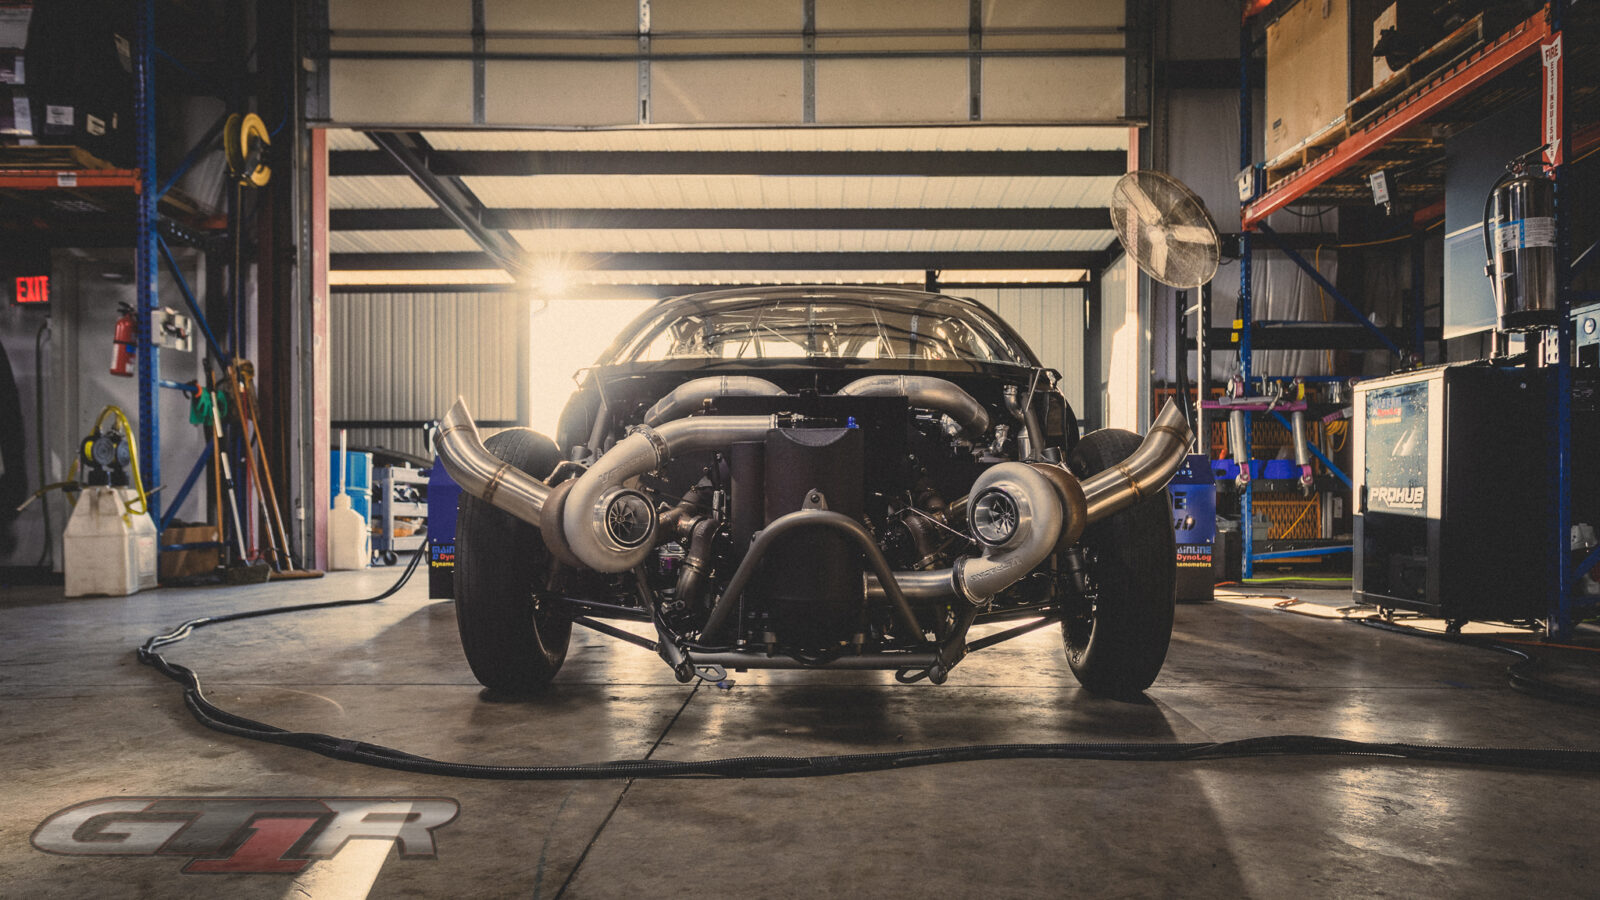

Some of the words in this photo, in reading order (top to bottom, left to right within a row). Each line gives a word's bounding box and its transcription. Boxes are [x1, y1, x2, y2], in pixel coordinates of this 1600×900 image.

[1545, 44, 1559, 62] FIRE
[16, 275, 49, 302] EXIT
[1369, 486, 1425, 504] PROHUB
[1176, 554, 1212, 562] DynoLog
